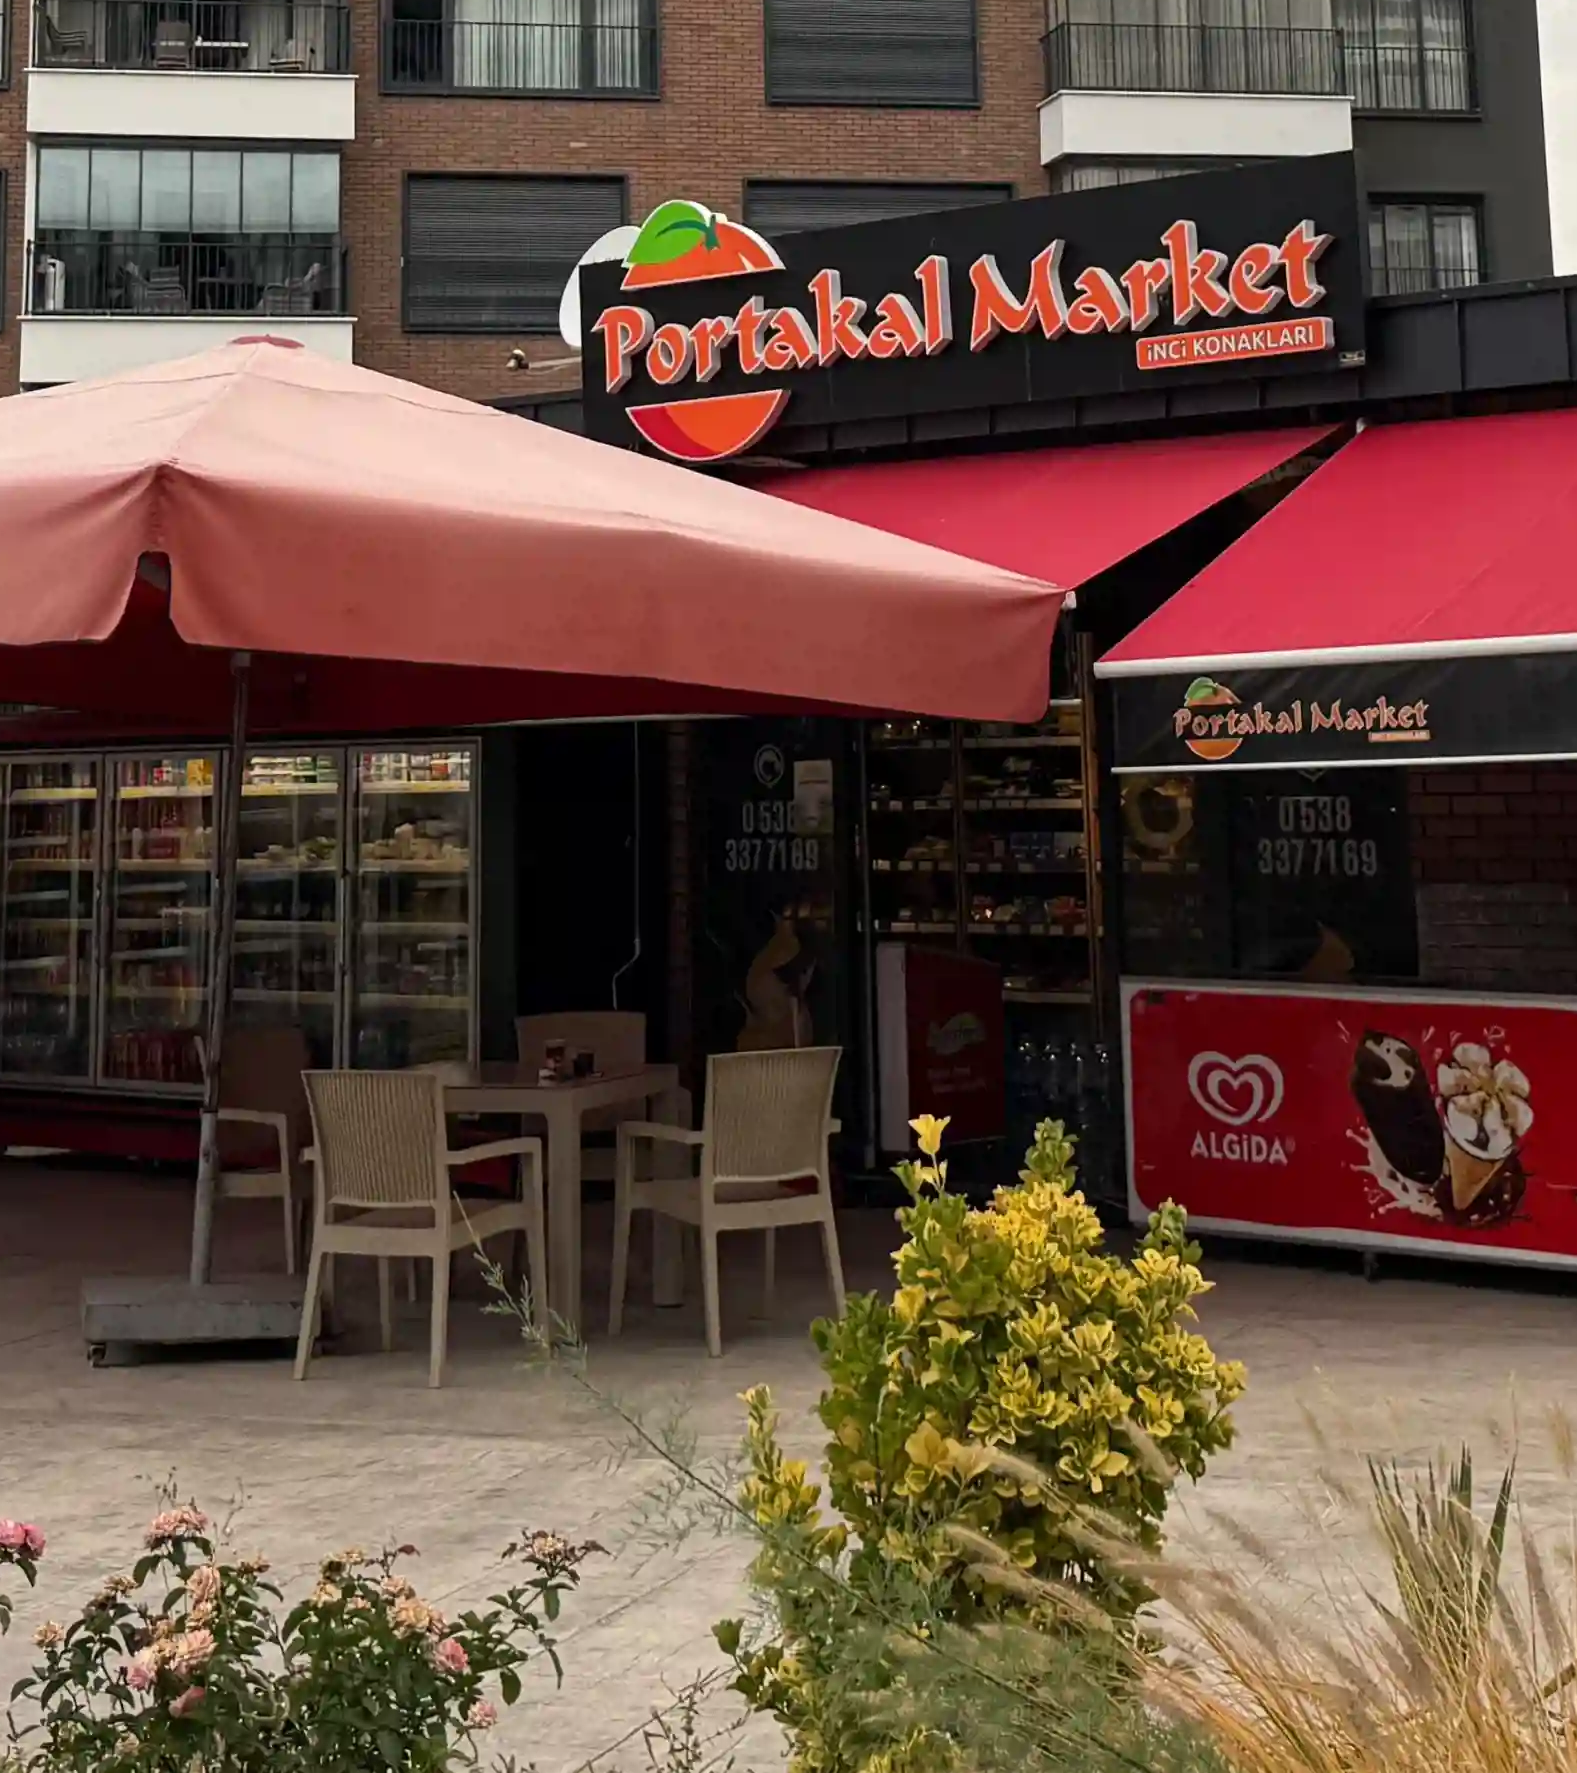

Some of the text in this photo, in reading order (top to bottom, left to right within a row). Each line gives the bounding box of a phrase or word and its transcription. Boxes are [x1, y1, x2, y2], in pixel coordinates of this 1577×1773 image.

[591, 218, 1335, 394] Portakal Market
[1192, 325, 1314, 358] KONAKLARI
[1173, 694, 1430, 739] Portakal Market
